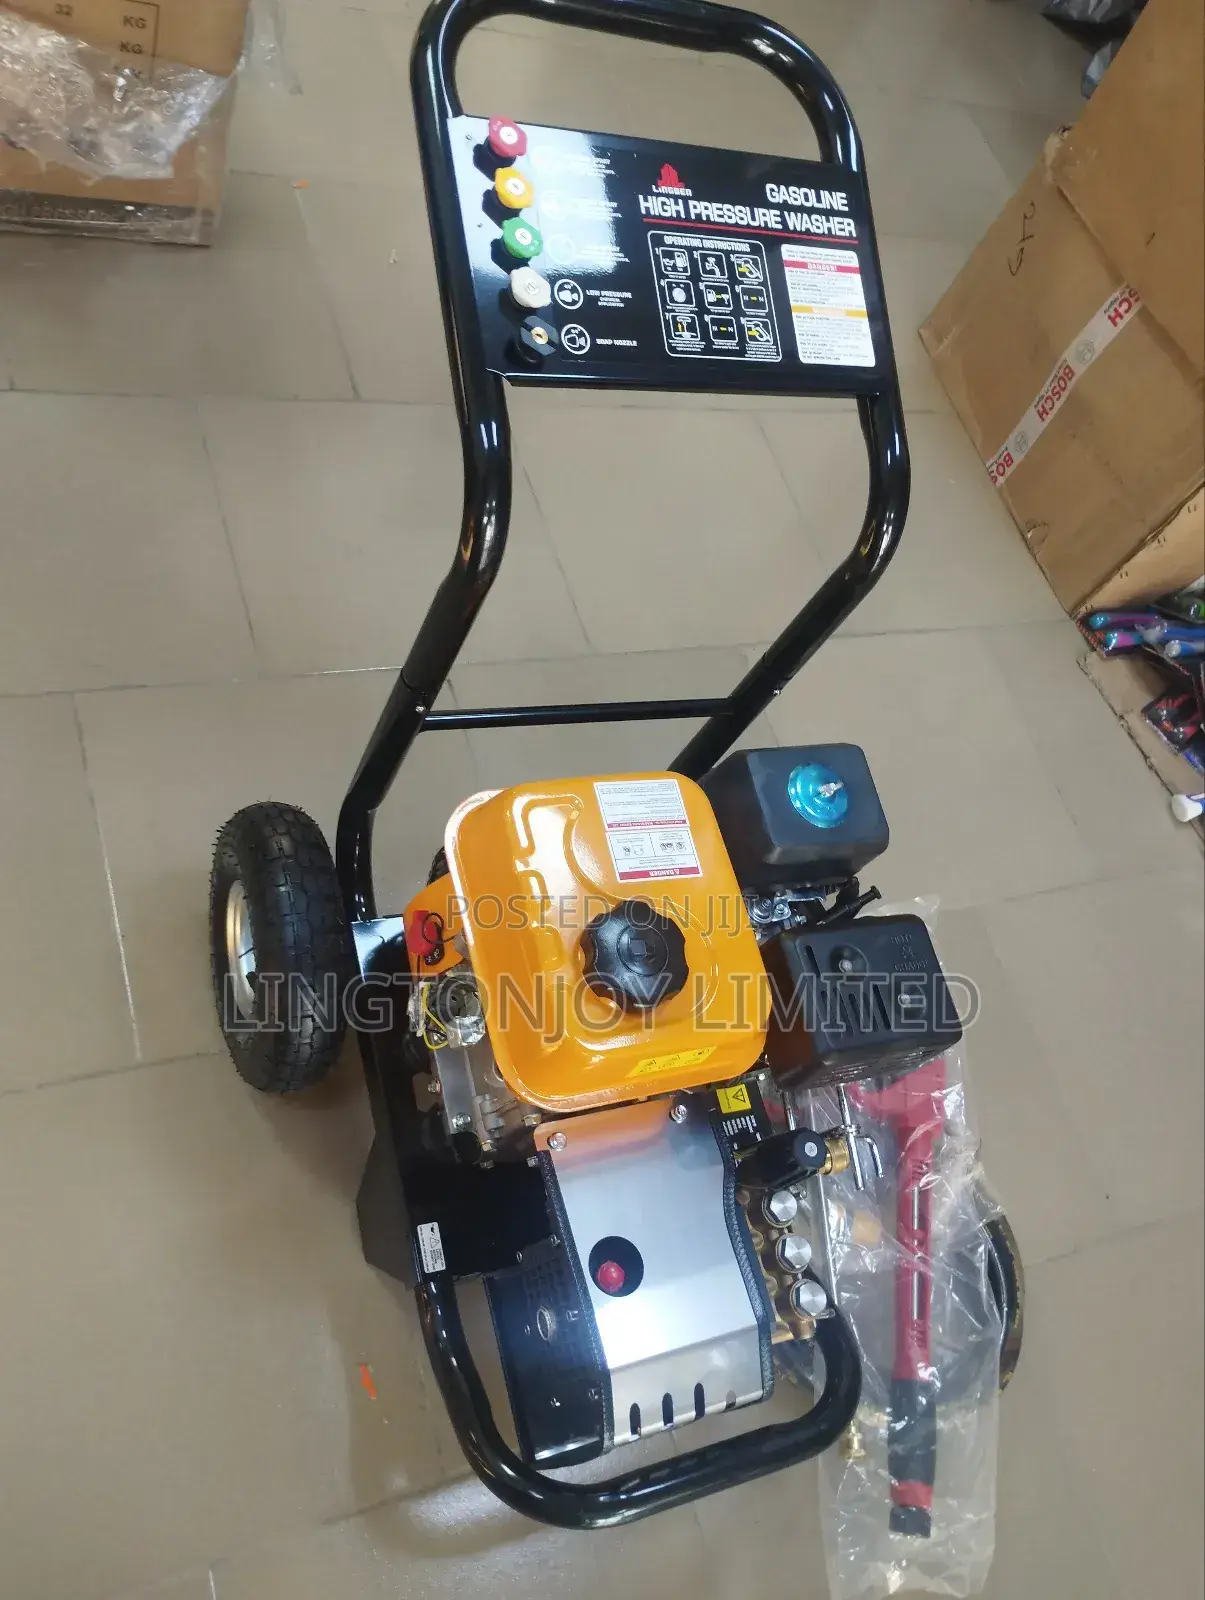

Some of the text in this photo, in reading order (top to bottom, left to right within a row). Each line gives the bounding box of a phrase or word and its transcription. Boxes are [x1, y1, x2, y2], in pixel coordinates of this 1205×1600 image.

[54, 3, 73, 17] 32
[122, 15, 147, 30] KG
[119, 41, 144, 55] KG
[765, 183, 849, 212] GASOLINE
[638, 194, 857, 238] HIGH PRESSURE WASHER
[664, 236, 751, 253] OPERATING INSTRUCTIONS
[806, 262, 838, 272] DANGER!
[1108, 287, 1141, 327] SCH
[1036, 364, 1076, 422] BOSCH
[649, 868, 674, 877] DANGER
